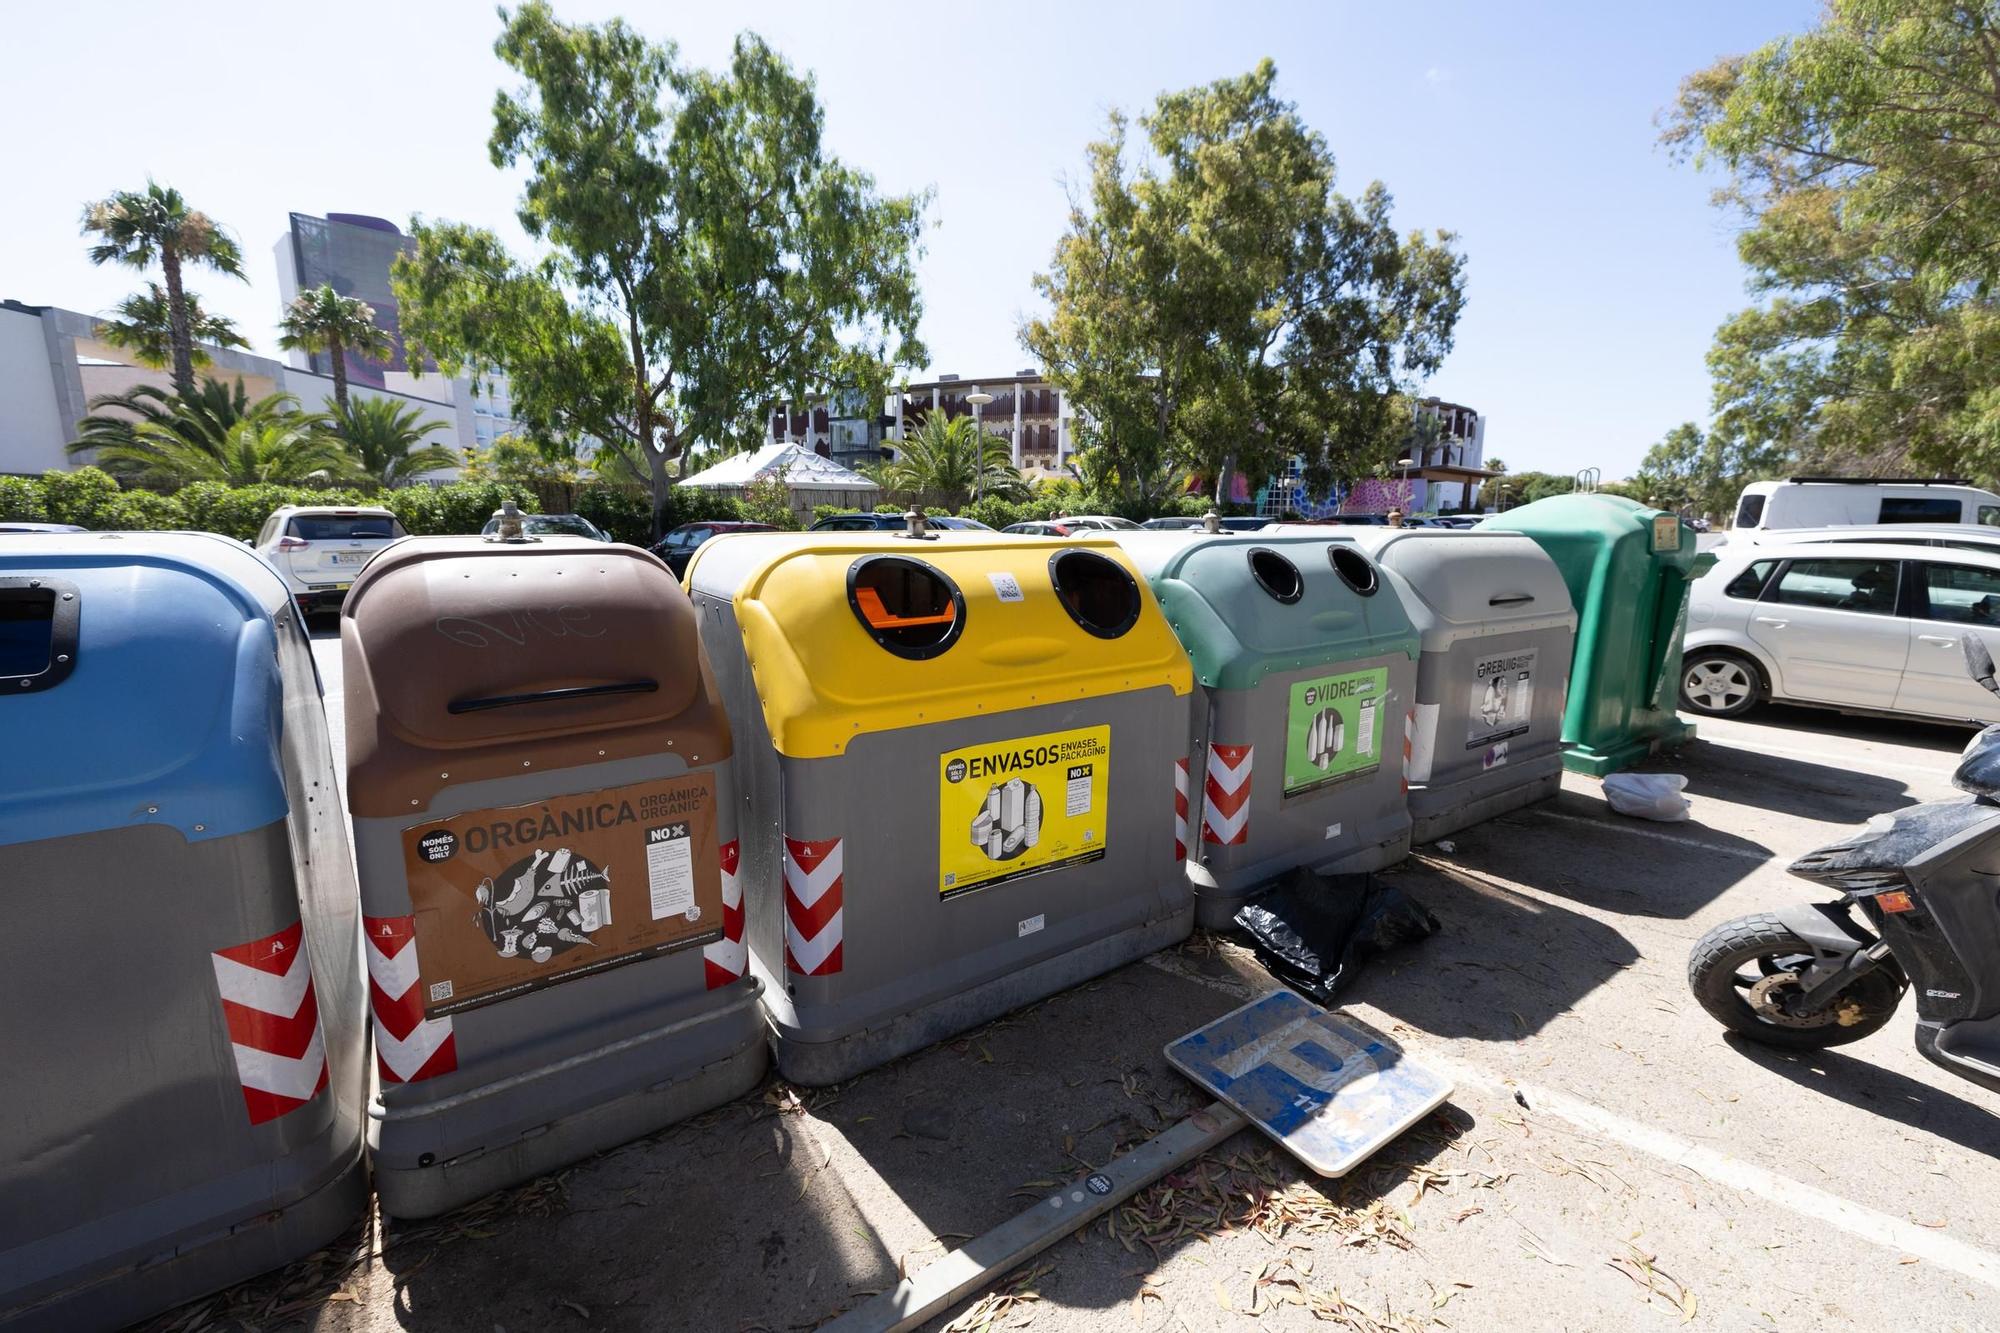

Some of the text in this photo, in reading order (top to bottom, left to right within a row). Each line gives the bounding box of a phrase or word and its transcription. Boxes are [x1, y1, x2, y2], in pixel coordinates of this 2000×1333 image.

[1486, 657, 1516, 675] REBUIG
[1318, 679, 1355, 702] VIDRE
[1061, 738, 1098, 752] ENVASES
[969, 745, 1059, 779] ENVASOS
[1060, 746, 1106, 762] PACKAGING
[1070, 769, 1082, 779] NO
[640, 786, 708, 809] ORGÁNICA
[640, 800, 700, 820] ORGANIC
[465, 800, 637, 854] ORGÀNICA
[650, 828, 670, 842] NO
[422, 835, 454, 848] NOMÉS
[428, 844, 450, 854] SÓLO
[429, 850, 450, 860] ONLY
[1212, 1016, 1379, 1095] P
